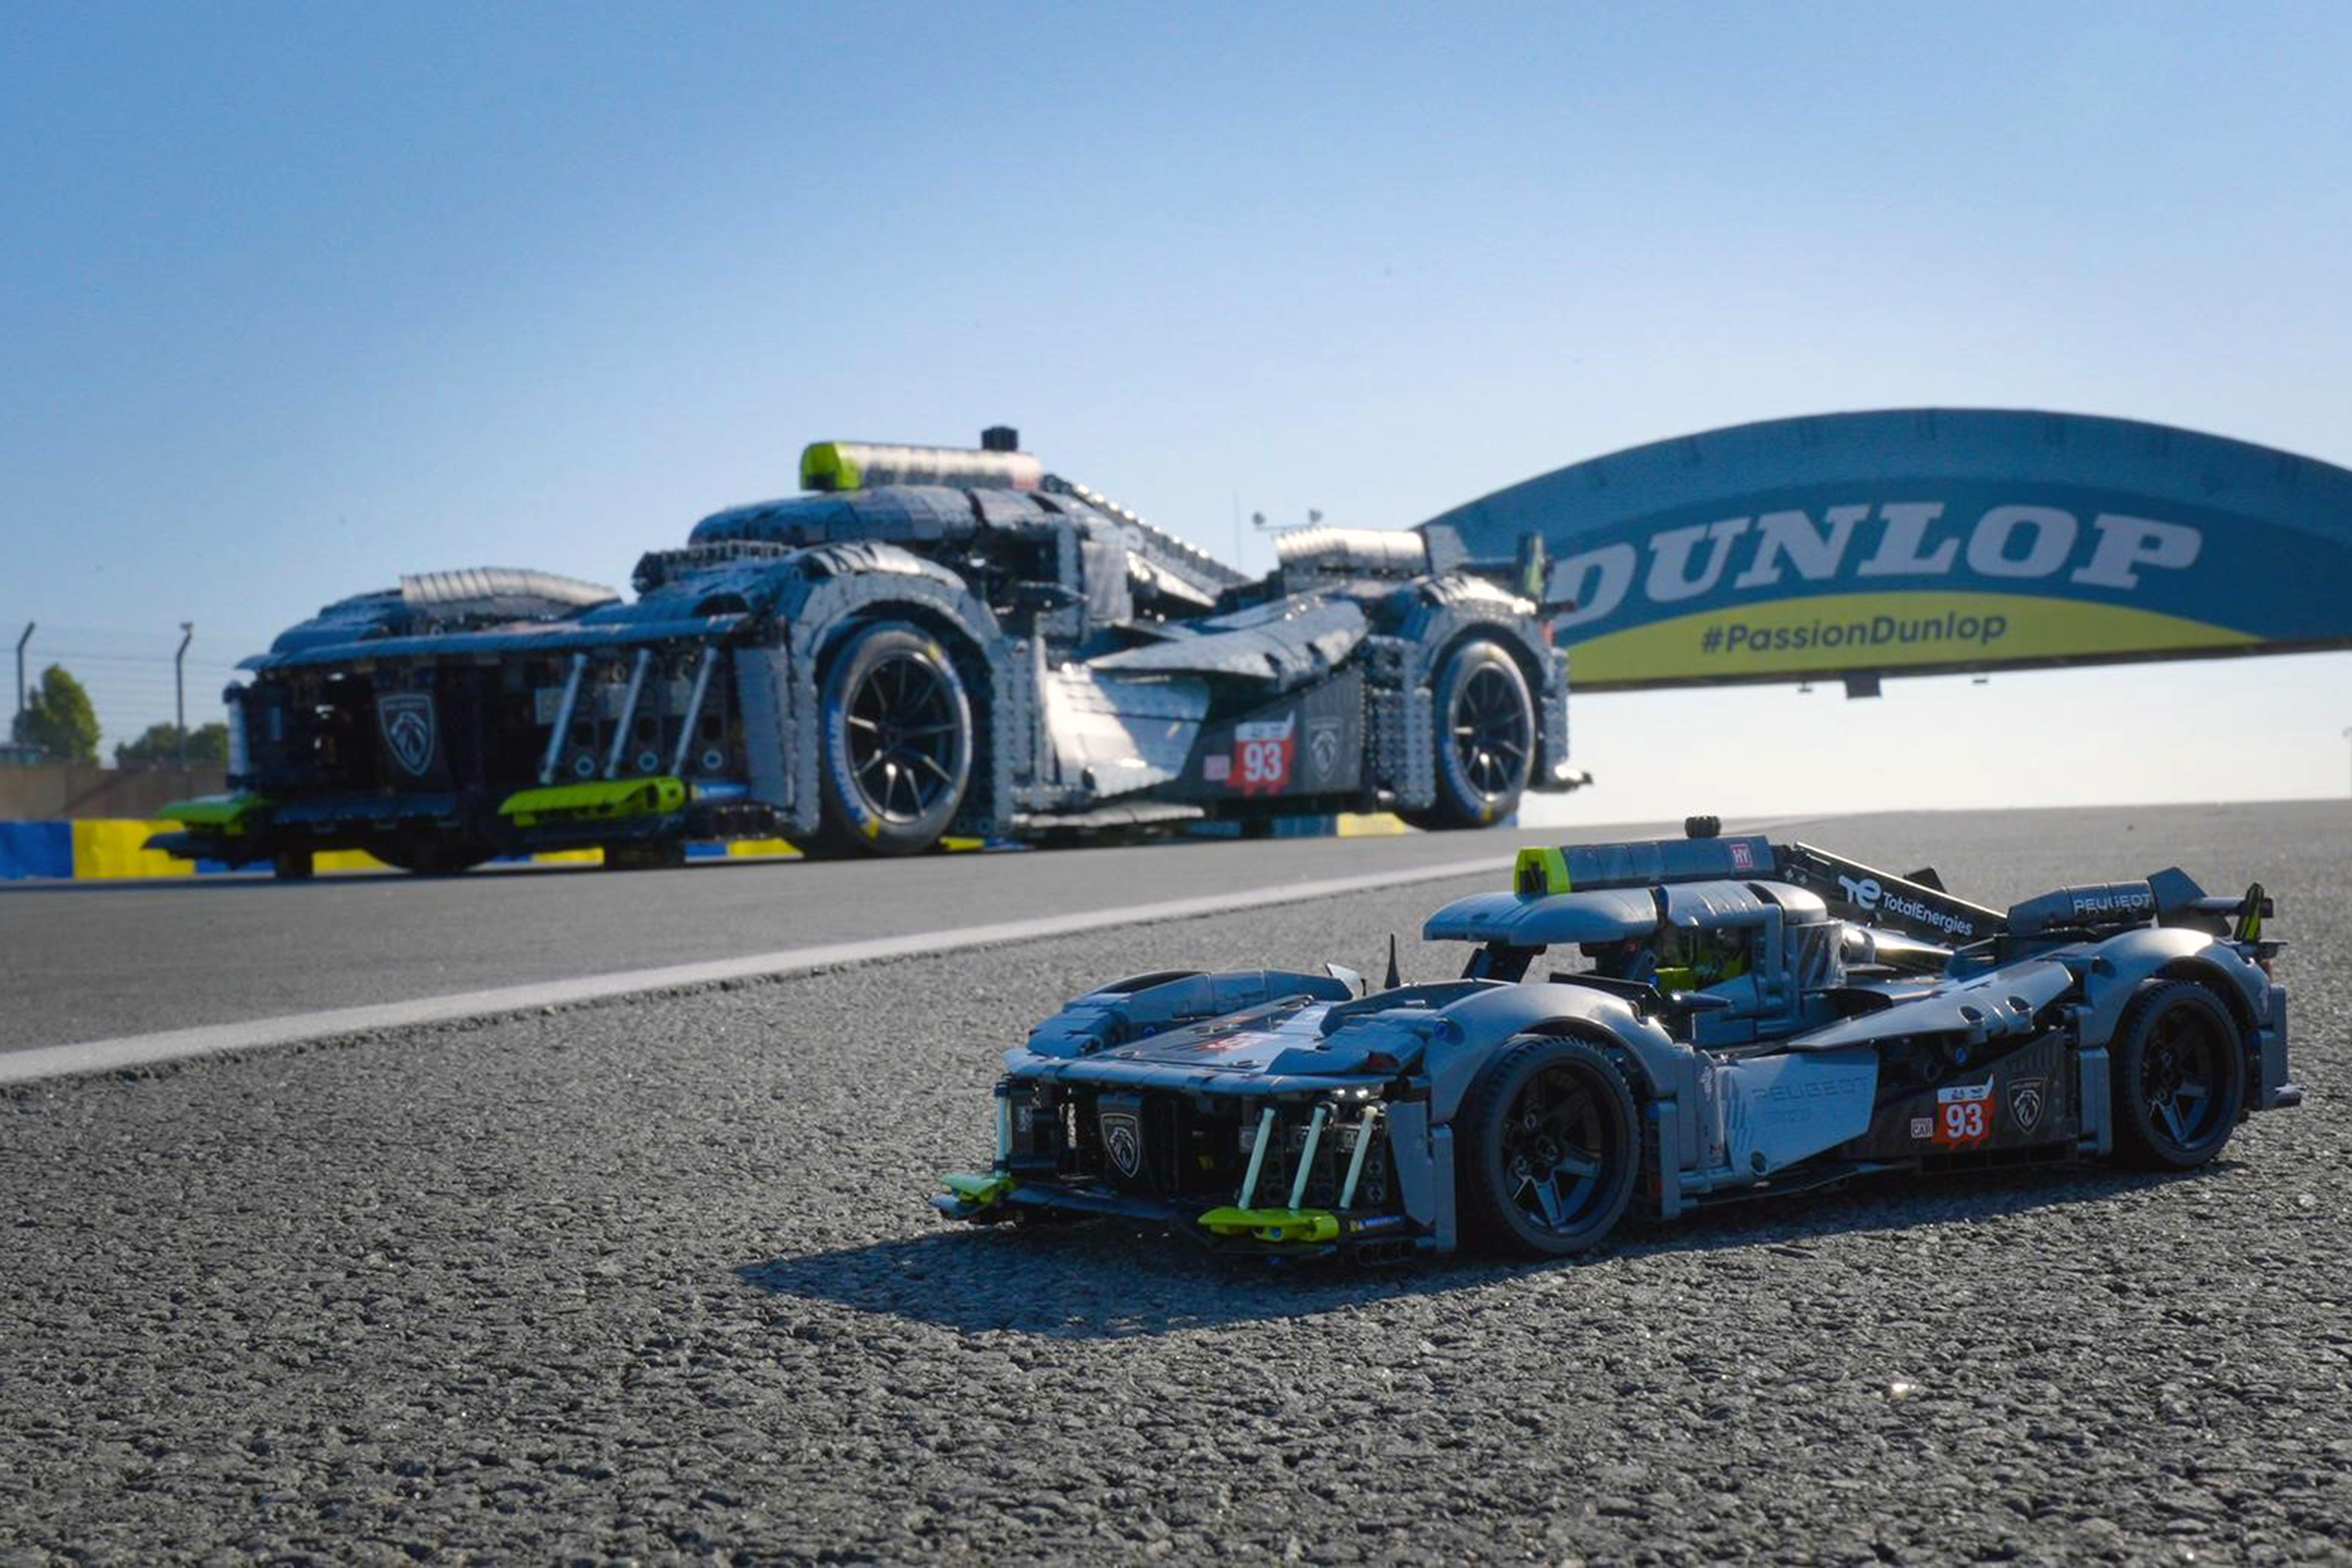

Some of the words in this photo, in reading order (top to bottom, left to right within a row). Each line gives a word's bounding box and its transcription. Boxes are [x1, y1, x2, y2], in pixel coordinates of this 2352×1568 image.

[1546, 501, 2203, 628] DUNLOP
[1702, 612, 2006, 653] #PassionDunlop
[1244, 742, 1283, 782] 93
[1882, 891, 1973, 935] TotalEnergies
[2073, 894, 2149, 912] PEUGEOT
[1946, 1103, 1984, 1138] 93
